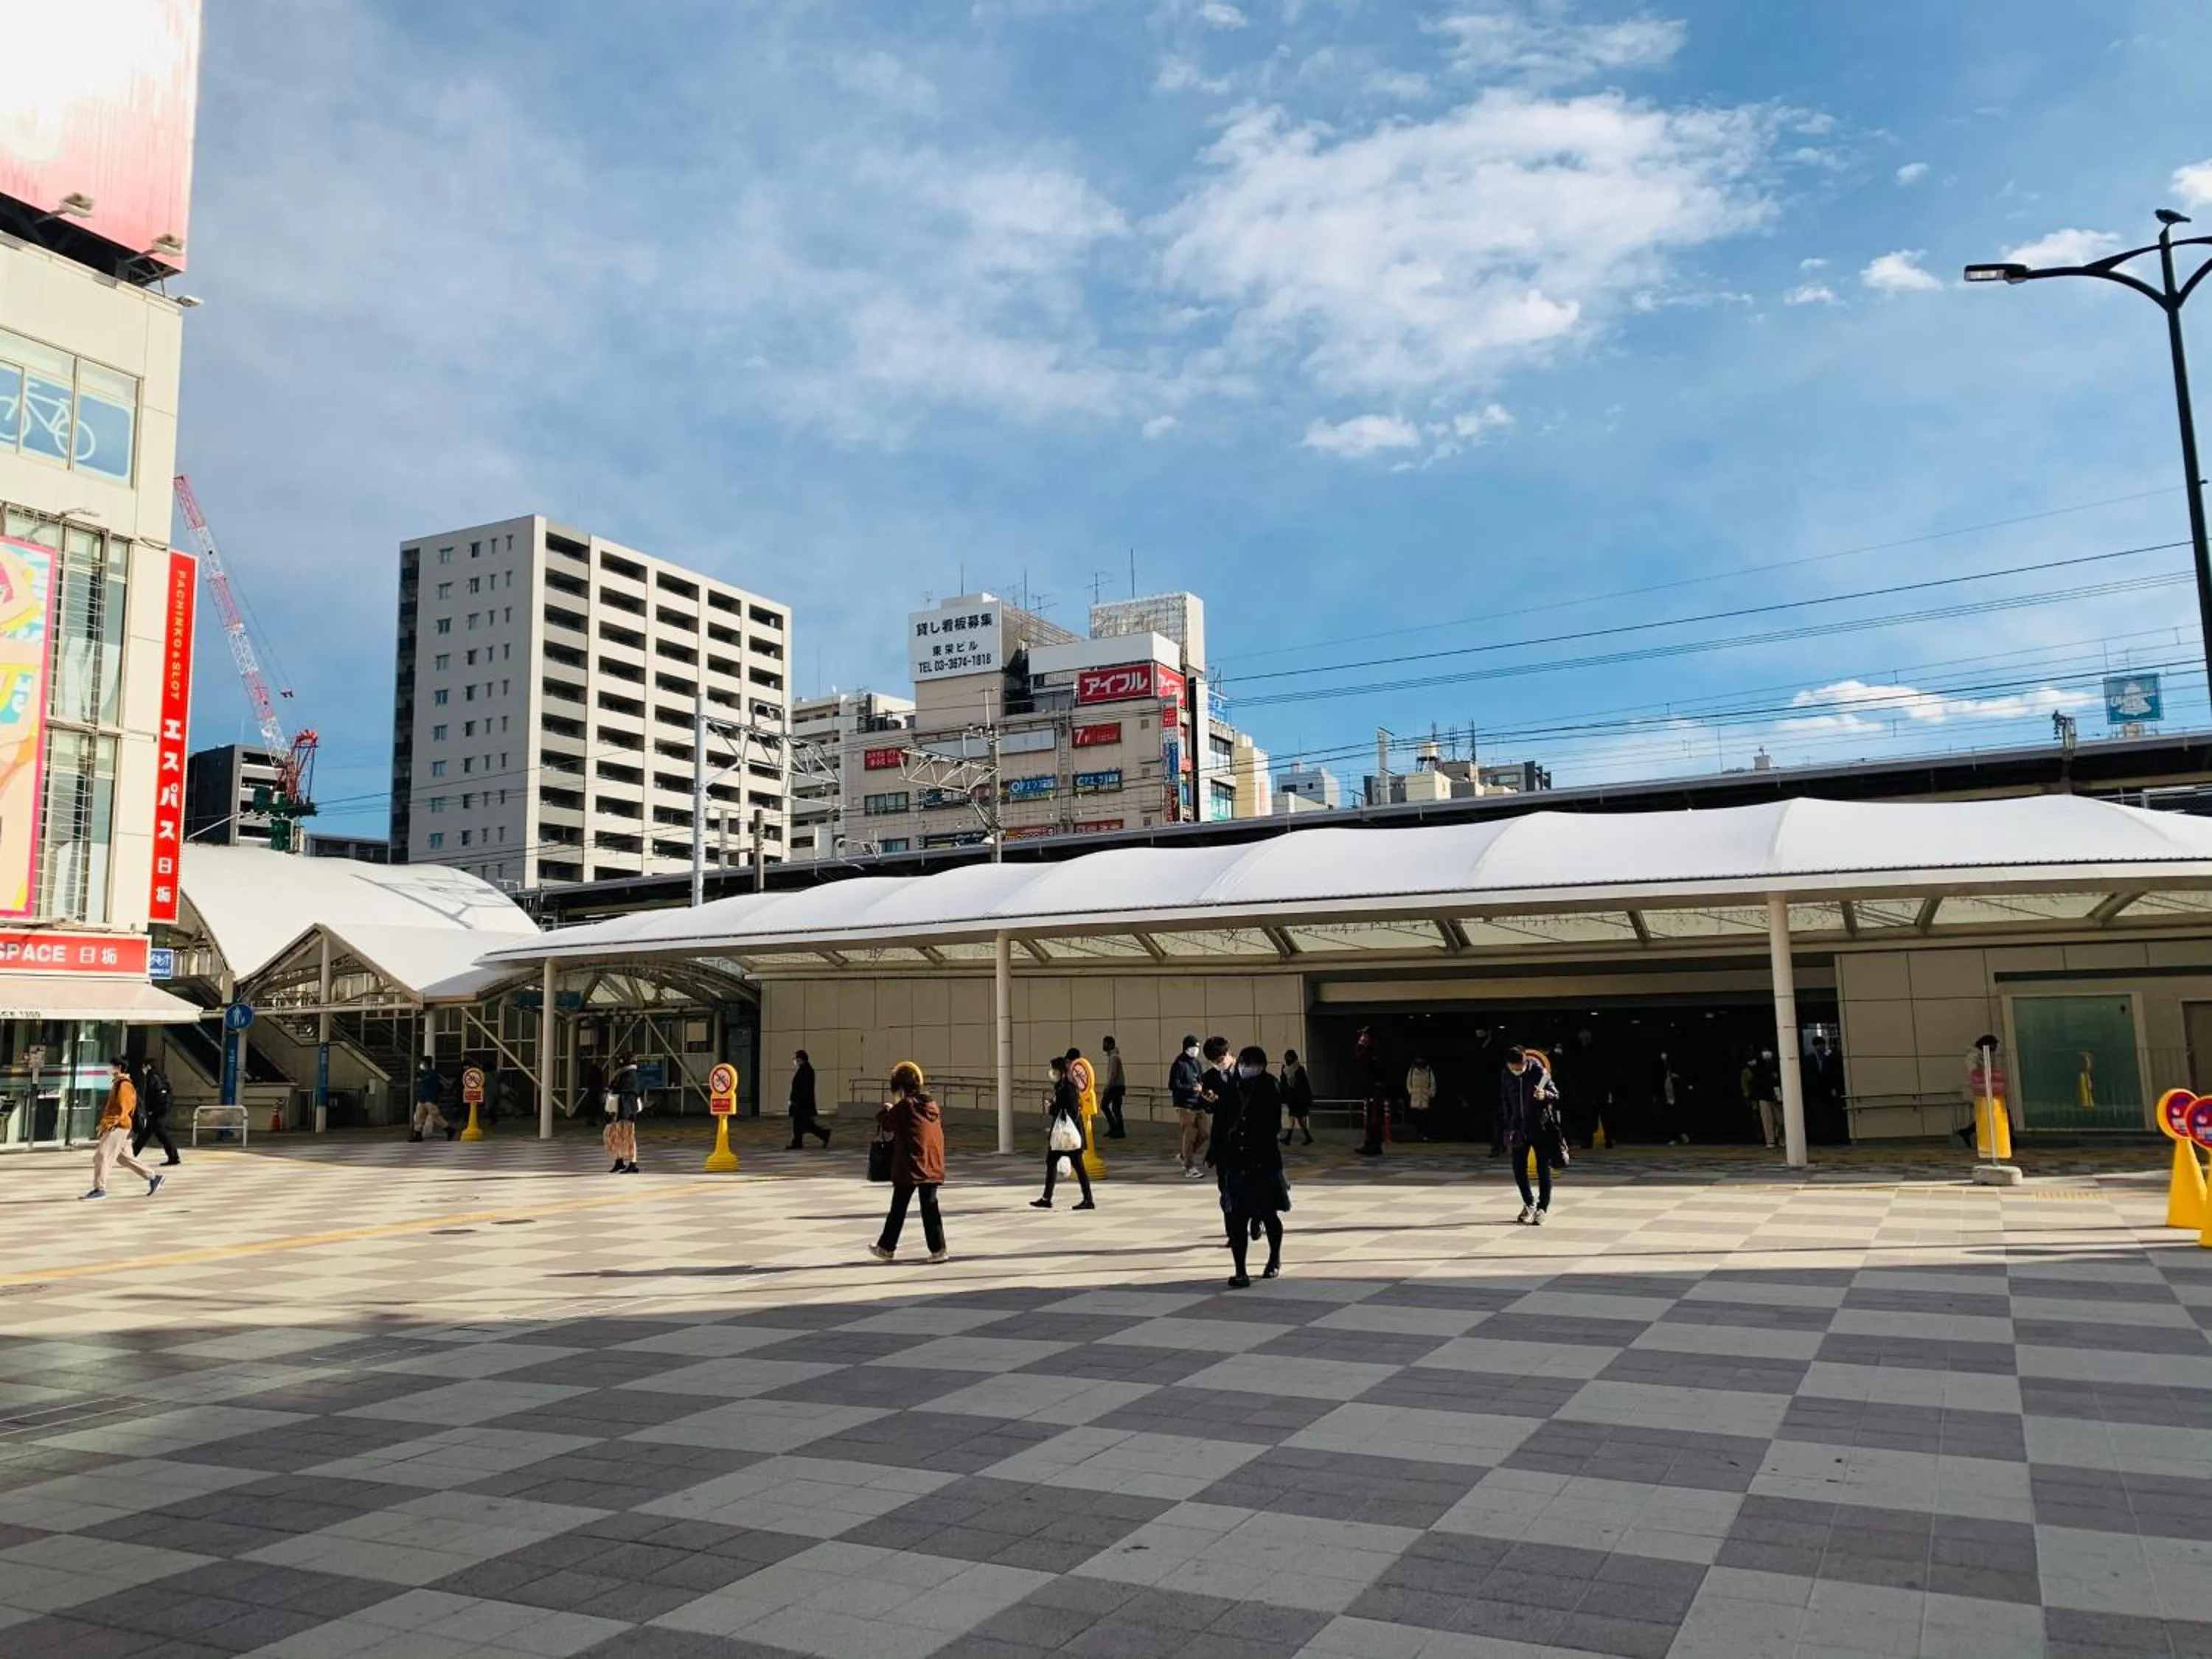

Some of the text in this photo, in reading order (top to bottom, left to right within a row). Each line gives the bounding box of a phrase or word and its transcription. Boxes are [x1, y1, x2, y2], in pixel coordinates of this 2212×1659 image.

[918, 661, 933, 672] TEL
[1085, 672, 1148, 695] アイフル
